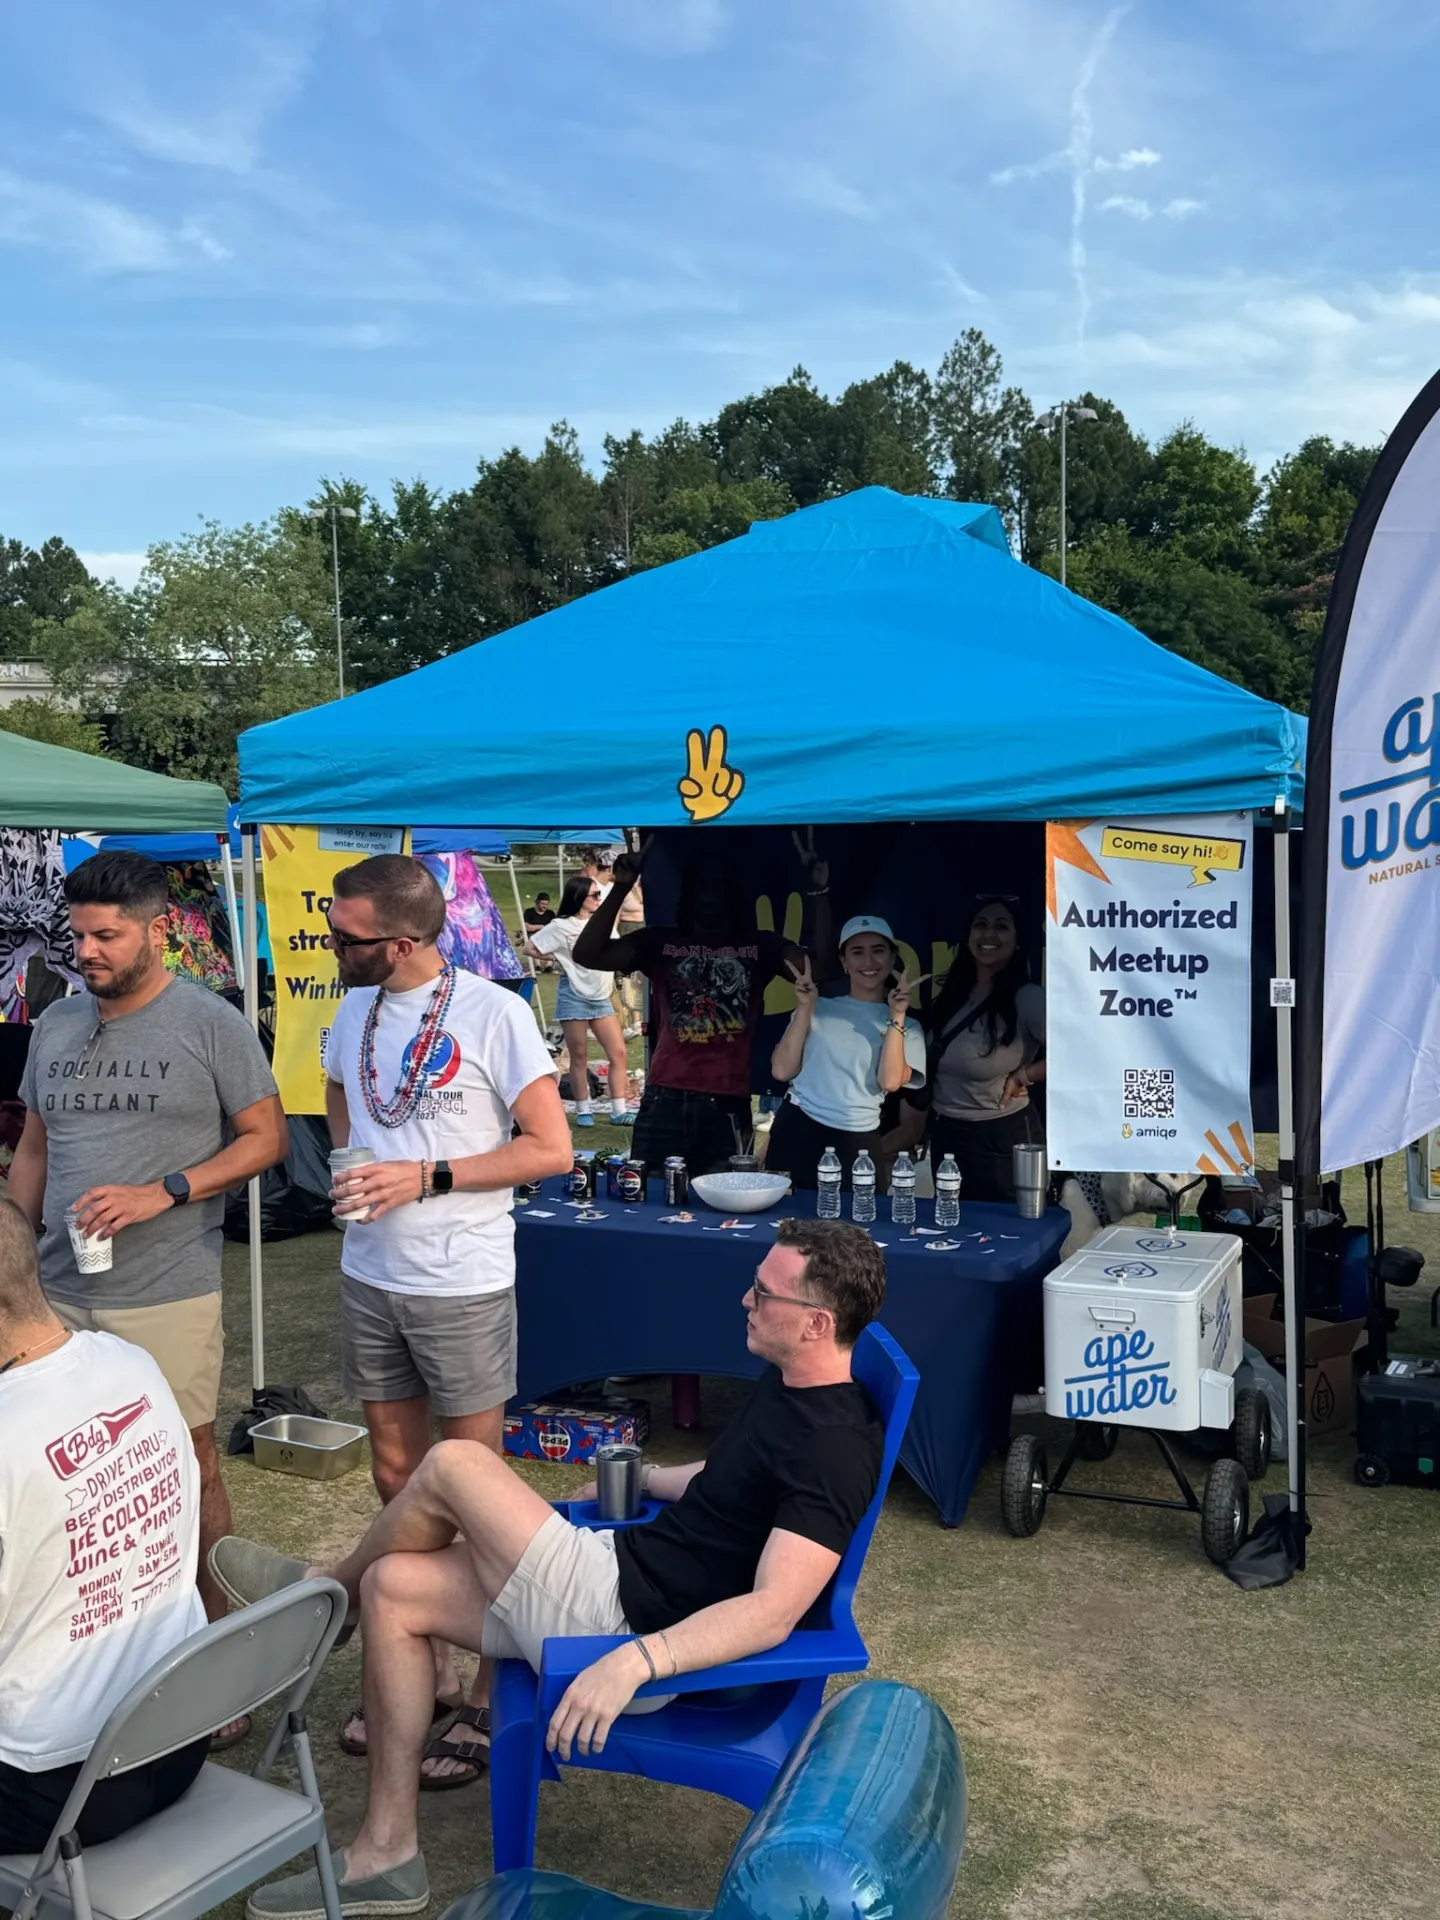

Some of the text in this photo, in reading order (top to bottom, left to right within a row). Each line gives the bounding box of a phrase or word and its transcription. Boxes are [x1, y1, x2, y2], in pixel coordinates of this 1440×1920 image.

[334, 840, 355, 848] enter
[335, 827, 354, 838] Stop
[369, 831, 382, 839] say
[1112, 836, 1213, 859] Come say hi!
[1369, 857, 1431, 885] NATURAL
[1061, 900, 1237, 929] Authorized
[1089, 945, 1209, 980] Meetup
[285, 975, 325, 999] Win
[48, 1060, 170, 1079] SOCIALLY
[46, 1093, 159, 1112] DISTANT
[437, 1091, 463, 1100] TOUR
[416, 1112, 435, 1121] 2023
[1084, 1330, 1154, 1383] ape
[1066, 1364, 1177, 1419] water
[540, 1434, 569, 1446] PEPSI
[87, 1435, 160, 1499] DRIVE THRU
[103, 1447, 178, 1508] DISTRIBUTOR
[103, 1494, 149, 1537] COLD
[150, 1468, 181, 1508] BEER
[66, 1540, 120, 1578] WINE
[124, 1534, 137, 1552] &
[79, 1568, 123, 1598] MONDAY
[84, 1586, 117, 1609] THRU
